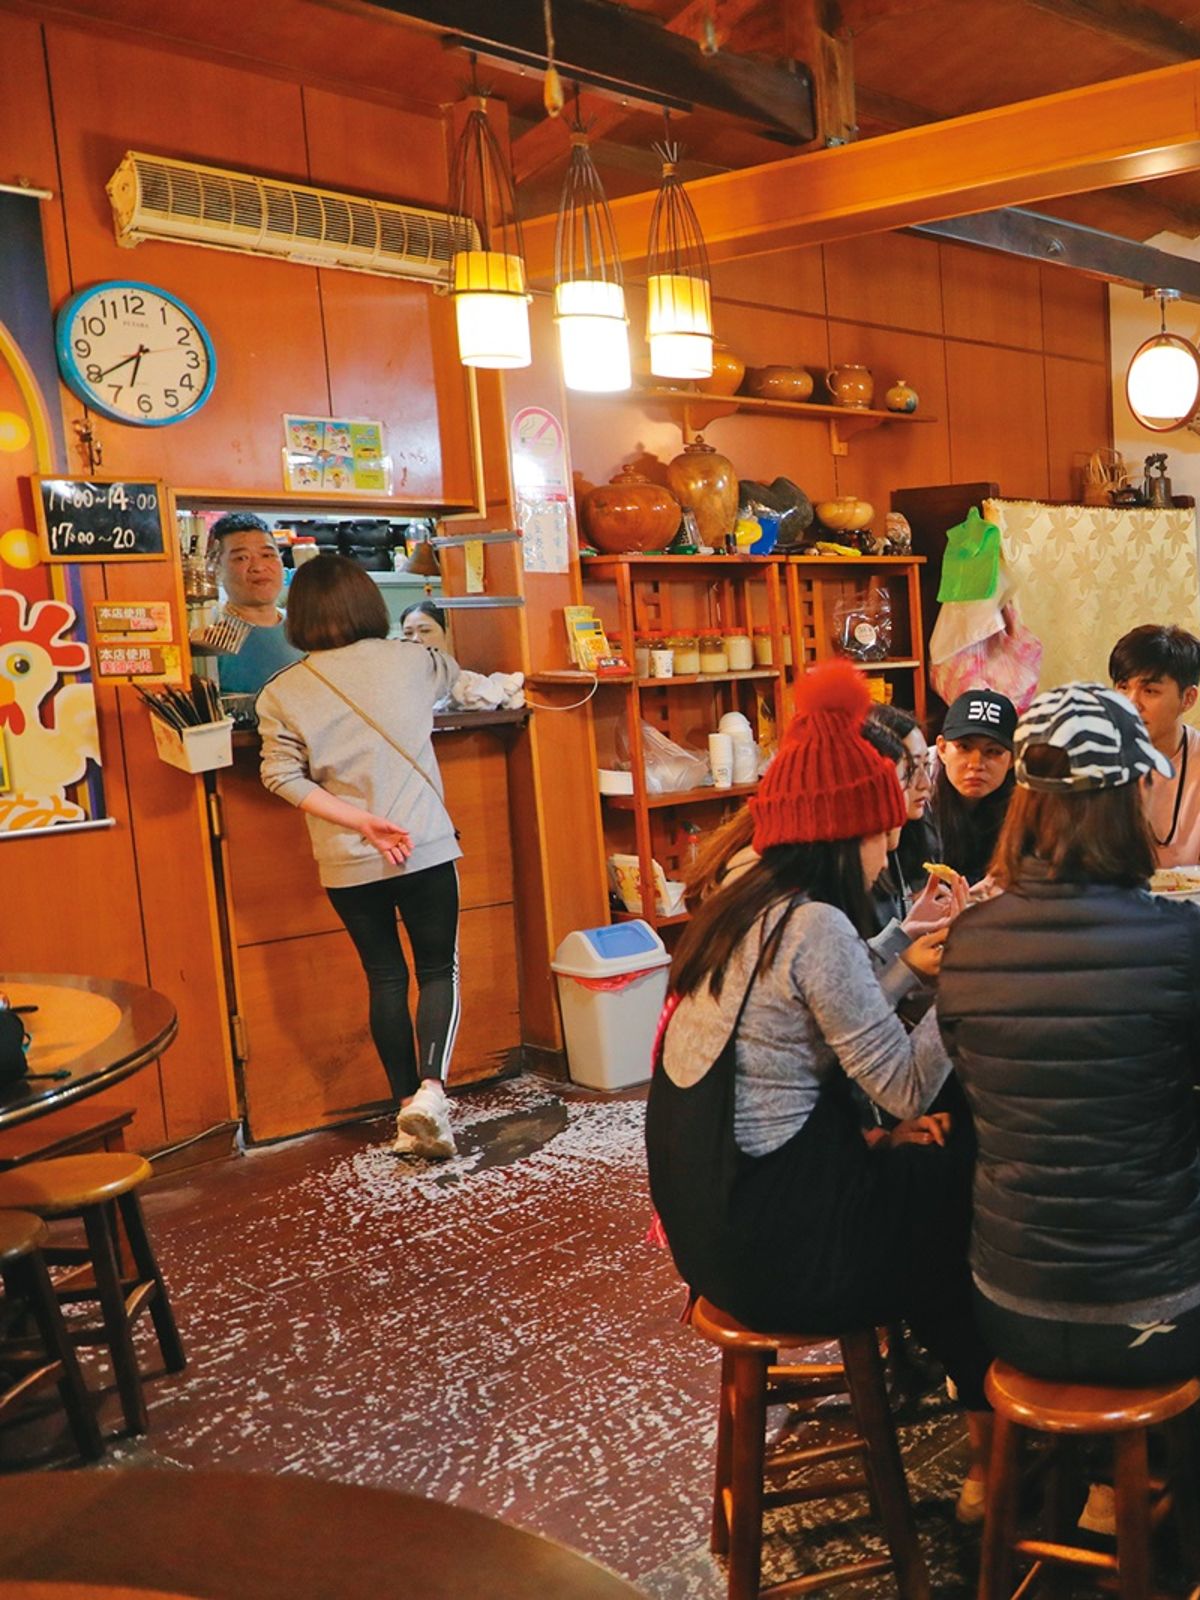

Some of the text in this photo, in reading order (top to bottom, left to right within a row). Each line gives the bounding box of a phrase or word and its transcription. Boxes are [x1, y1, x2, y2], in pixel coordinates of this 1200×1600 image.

[100, 299, 118, 319] 11
[122, 295, 146, 315] 12
[160, 306, 167, 325] 1
[81, 316, 106, 336] 10
[176, 327, 191, 346] 2
[74, 338, 91, 358] 9
[185, 350, 200, 369] 3
[86, 364, 103, 384] 8
[179, 373, 194, 391] 4
[108, 384, 123, 403] 7
[164, 389, 179, 408] 5
[137, 394, 153, 413] 6
[100, 607, 146, 619] 本店使用
[100, 648, 151, 661] 本店使用
